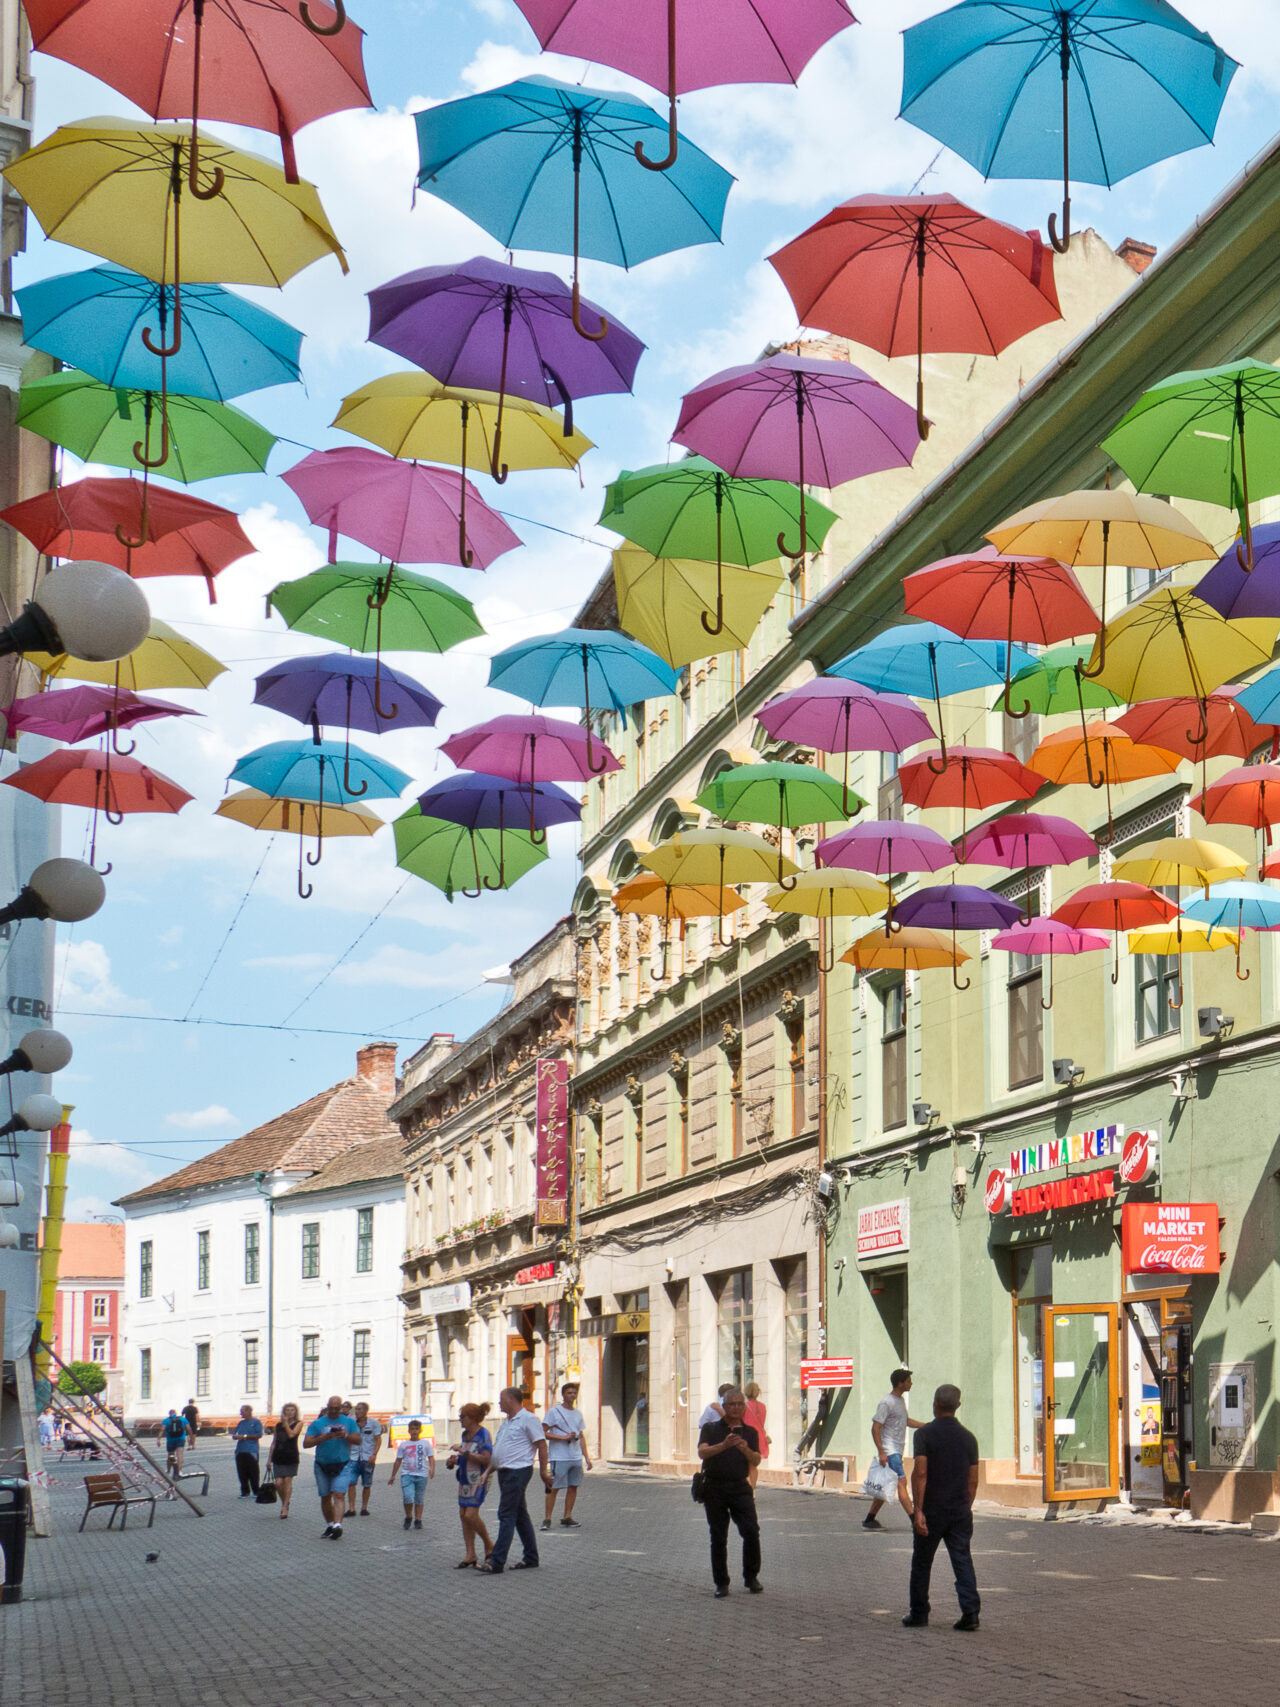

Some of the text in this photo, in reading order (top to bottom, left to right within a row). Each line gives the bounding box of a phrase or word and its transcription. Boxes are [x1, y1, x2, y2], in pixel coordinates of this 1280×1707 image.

[540, 1062, 568, 1199] Restaurant
[1010, 1124, 1118, 1178] MINI MARKET
[1158, 1207, 1190, 1221] MINI
[1143, 1222, 1206, 1236] MARKET
[1140, 1244, 1208, 1269] Coca-Cola
